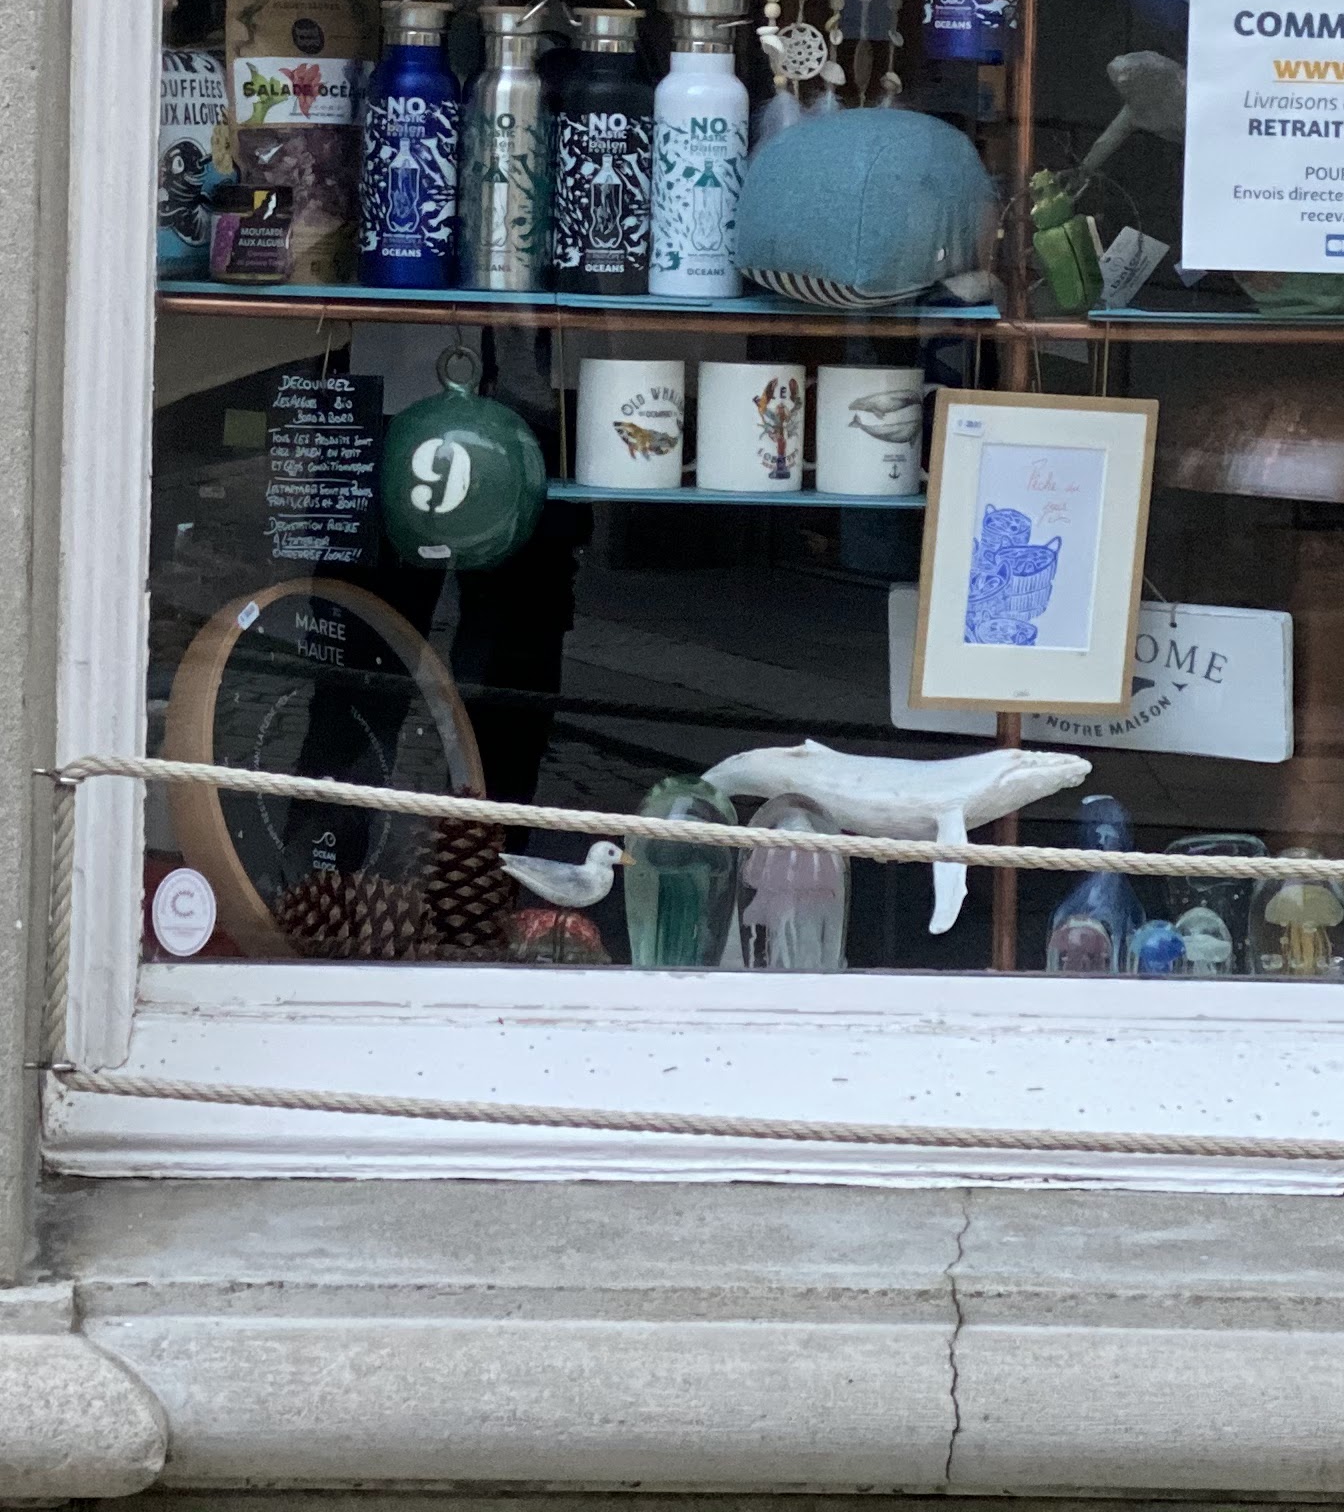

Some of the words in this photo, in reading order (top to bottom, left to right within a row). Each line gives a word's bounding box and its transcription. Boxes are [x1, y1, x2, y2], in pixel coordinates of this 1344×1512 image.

[388, 96, 426, 115] NO
[1244, 91, 1337, 113] Livraisons
[589, 112, 627, 131] NO
[691, 117, 728, 135] NO
[1248, 119, 1343, 139] RETRAIT
[1233, 185, 1284, 201] Envois
[382, 248, 422, 258] OCEANS
[410, 438, 471, 514] 9
[1045, 715, 1103, 737] NOTRE
[1109, 694, 1172, 735] MAISON
